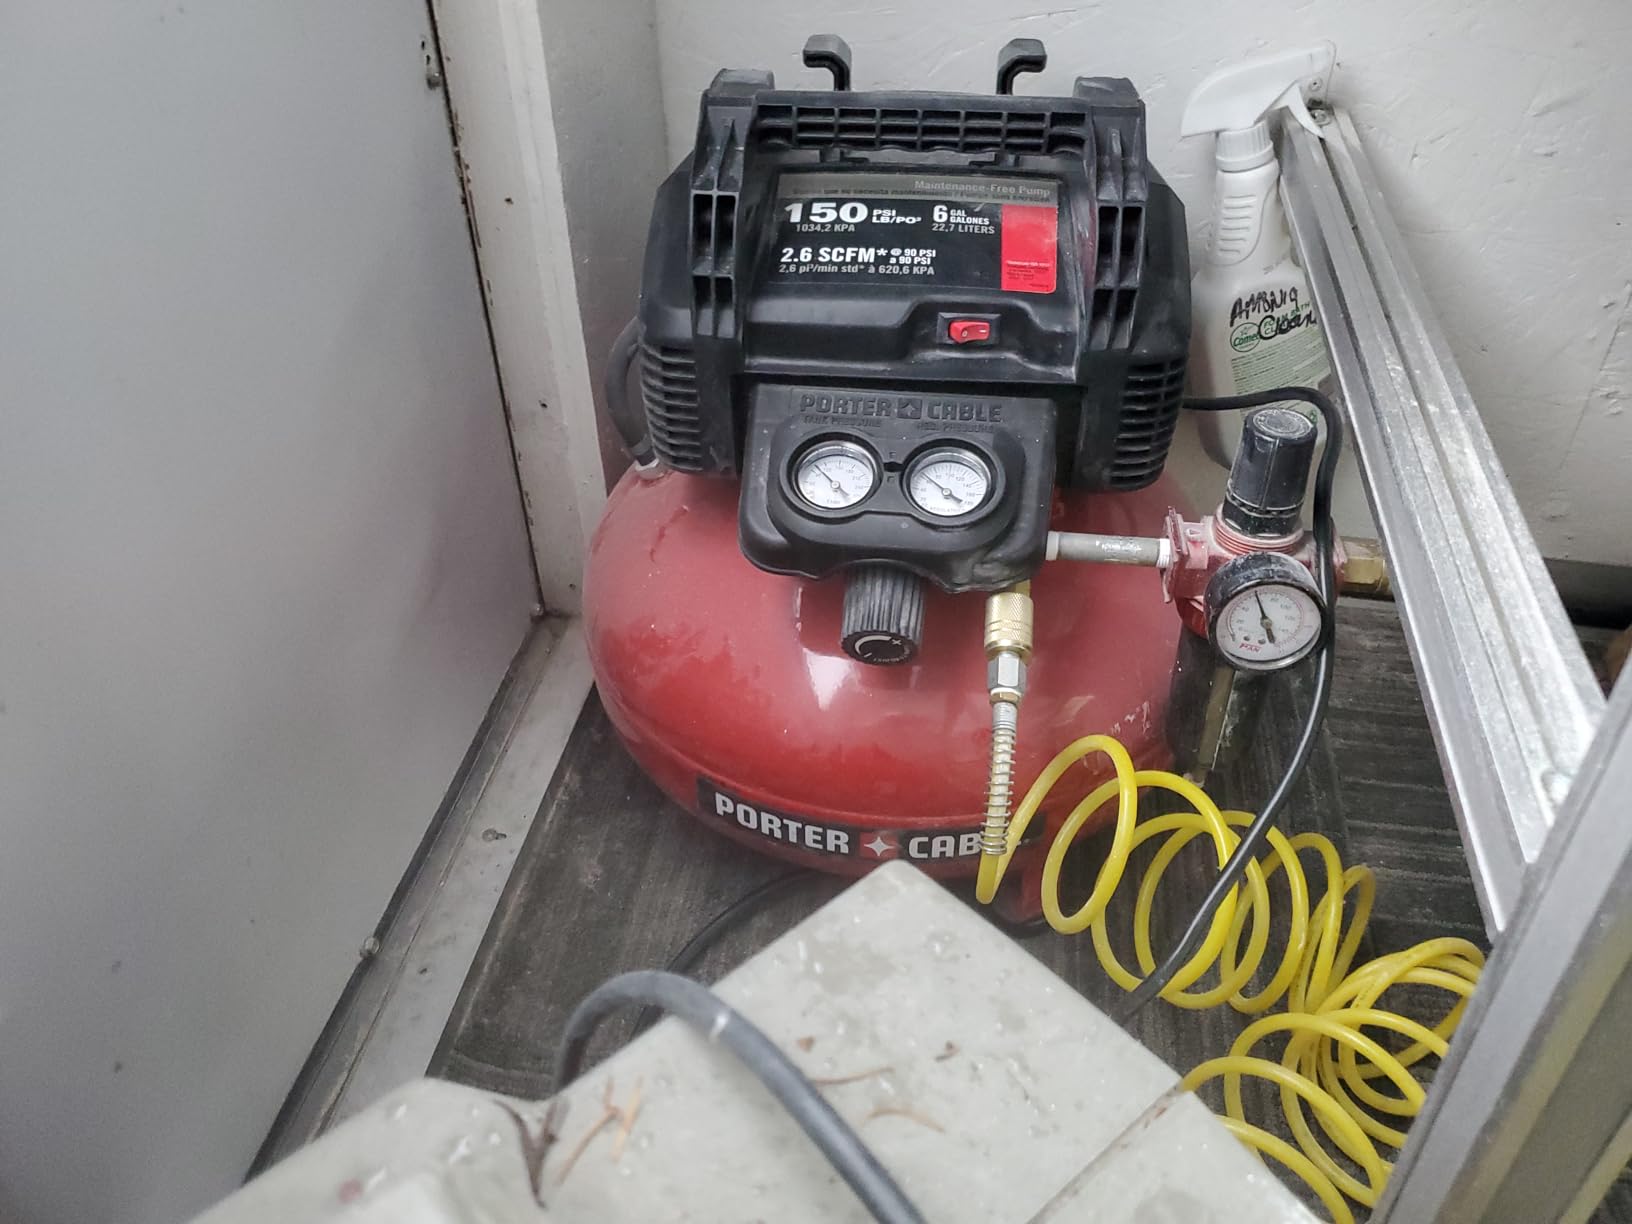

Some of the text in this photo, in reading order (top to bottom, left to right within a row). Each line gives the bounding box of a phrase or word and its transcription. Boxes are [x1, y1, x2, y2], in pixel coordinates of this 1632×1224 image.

[1019, 186, 1051, 199] Pump
[784, 202, 897, 223] 150 PSI
[933, 205, 967, 222] 6 GAL
[950, 216, 990, 225] GALONES
[834, 224, 856, 232] KPA
[958, 224, 996, 235] LITERS
[780, 247, 813, 263] 2.6
[904, 248, 917, 257] 90
[919, 249, 937, 258] PSI
[899, 256, 912, 265] 90
[913, 257, 932, 265] PSI
[912, 266, 935, 276] KPA
[800, 394, 1003, 423] PORTER CABLE
[714, 792, 850, 855] PORTER
